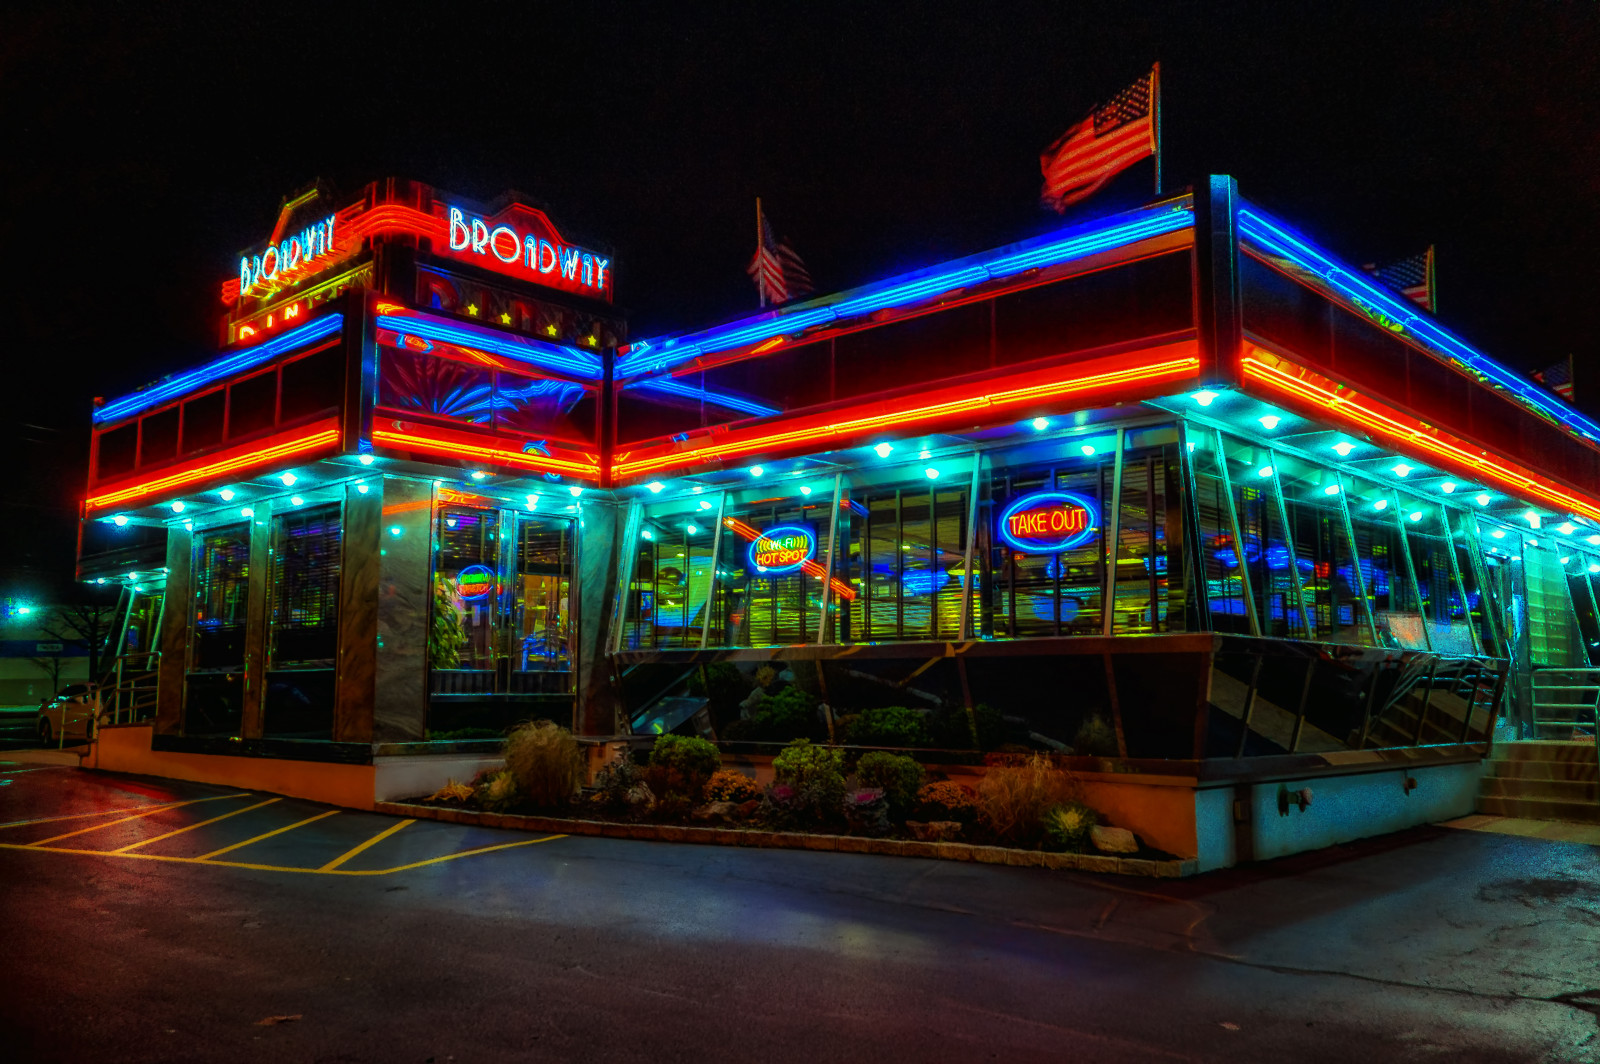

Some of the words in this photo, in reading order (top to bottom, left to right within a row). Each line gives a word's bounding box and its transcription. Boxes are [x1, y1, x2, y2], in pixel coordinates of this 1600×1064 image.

[239, 213, 336, 295] BROADWAY
[449, 206, 609, 289] BROADWAY
[1009, 513, 1047, 535] TAKE
[1051, 508, 1086, 531] OUT
[756, 552, 778, 565] HOT
[779, 548, 808, 563] SPOT
